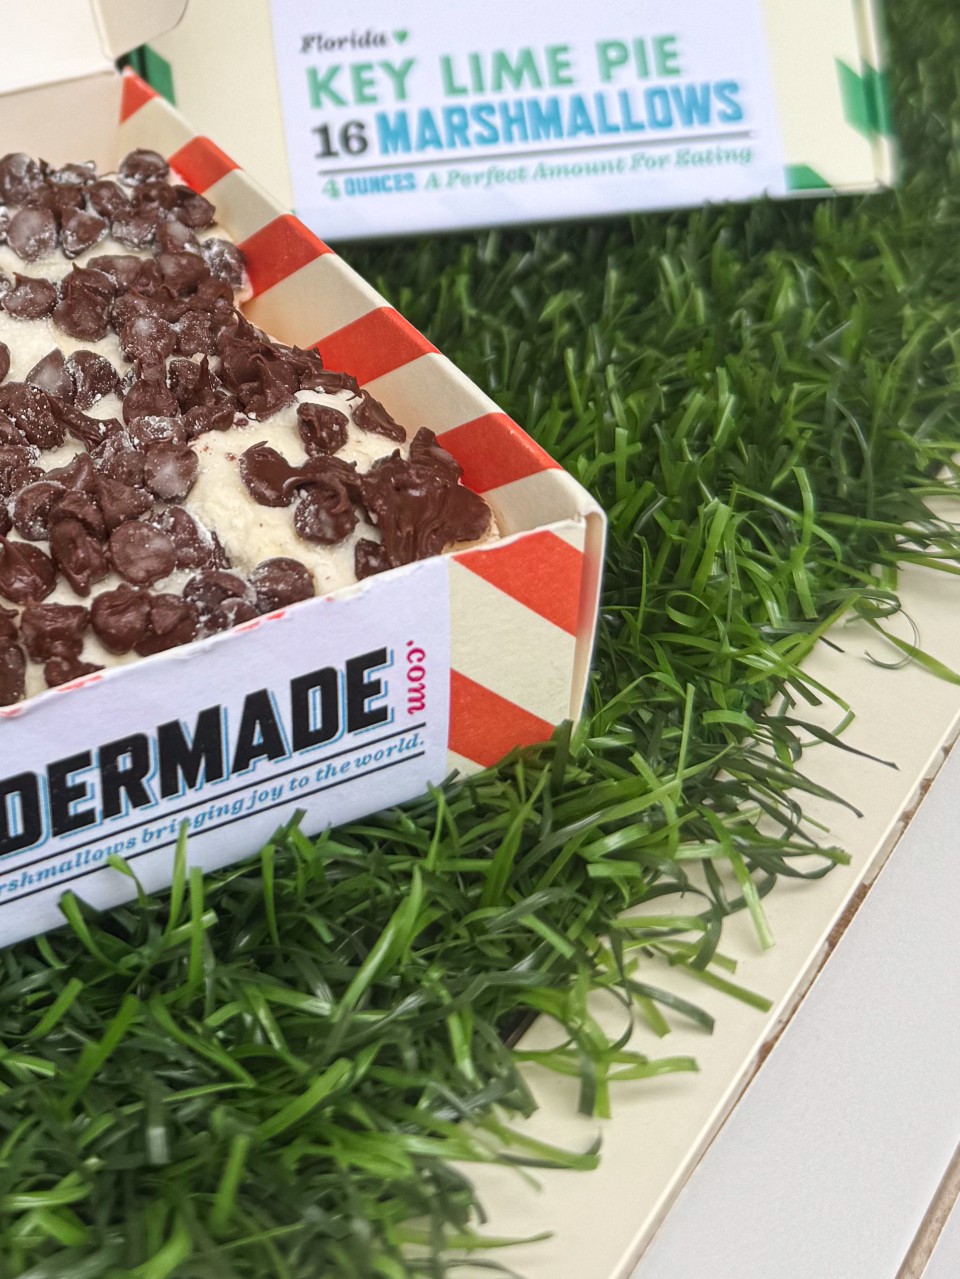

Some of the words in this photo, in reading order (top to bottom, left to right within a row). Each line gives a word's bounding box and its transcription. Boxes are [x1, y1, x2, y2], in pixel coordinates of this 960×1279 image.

[299, 28, 388, 53] Florida
[305, 57, 416, 110] KEY
[440, 43, 575, 99] LIME
[595, 35, 683, 83] PIE
[311, 120, 369, 160] 16
[374, 80, 745, 156] MARSHMALLOWS
[321, 177, 340, 200] 4
[344, 171, 417, 197] OUNCES
[422, 173, 440, 190] A
[445, 163, 529, 190] Perfect
[530, 158, 626, 181] Amount
[630, 150, 671, 170] For
[674, 144, 753, 167] Eating
[406, 640, 427, 716] .com
[245, 783, 284, 811] joy
[289, 775, 309, 793] to
[315, 761, 350, 785] the
[354, 732, 425, 769] world.
